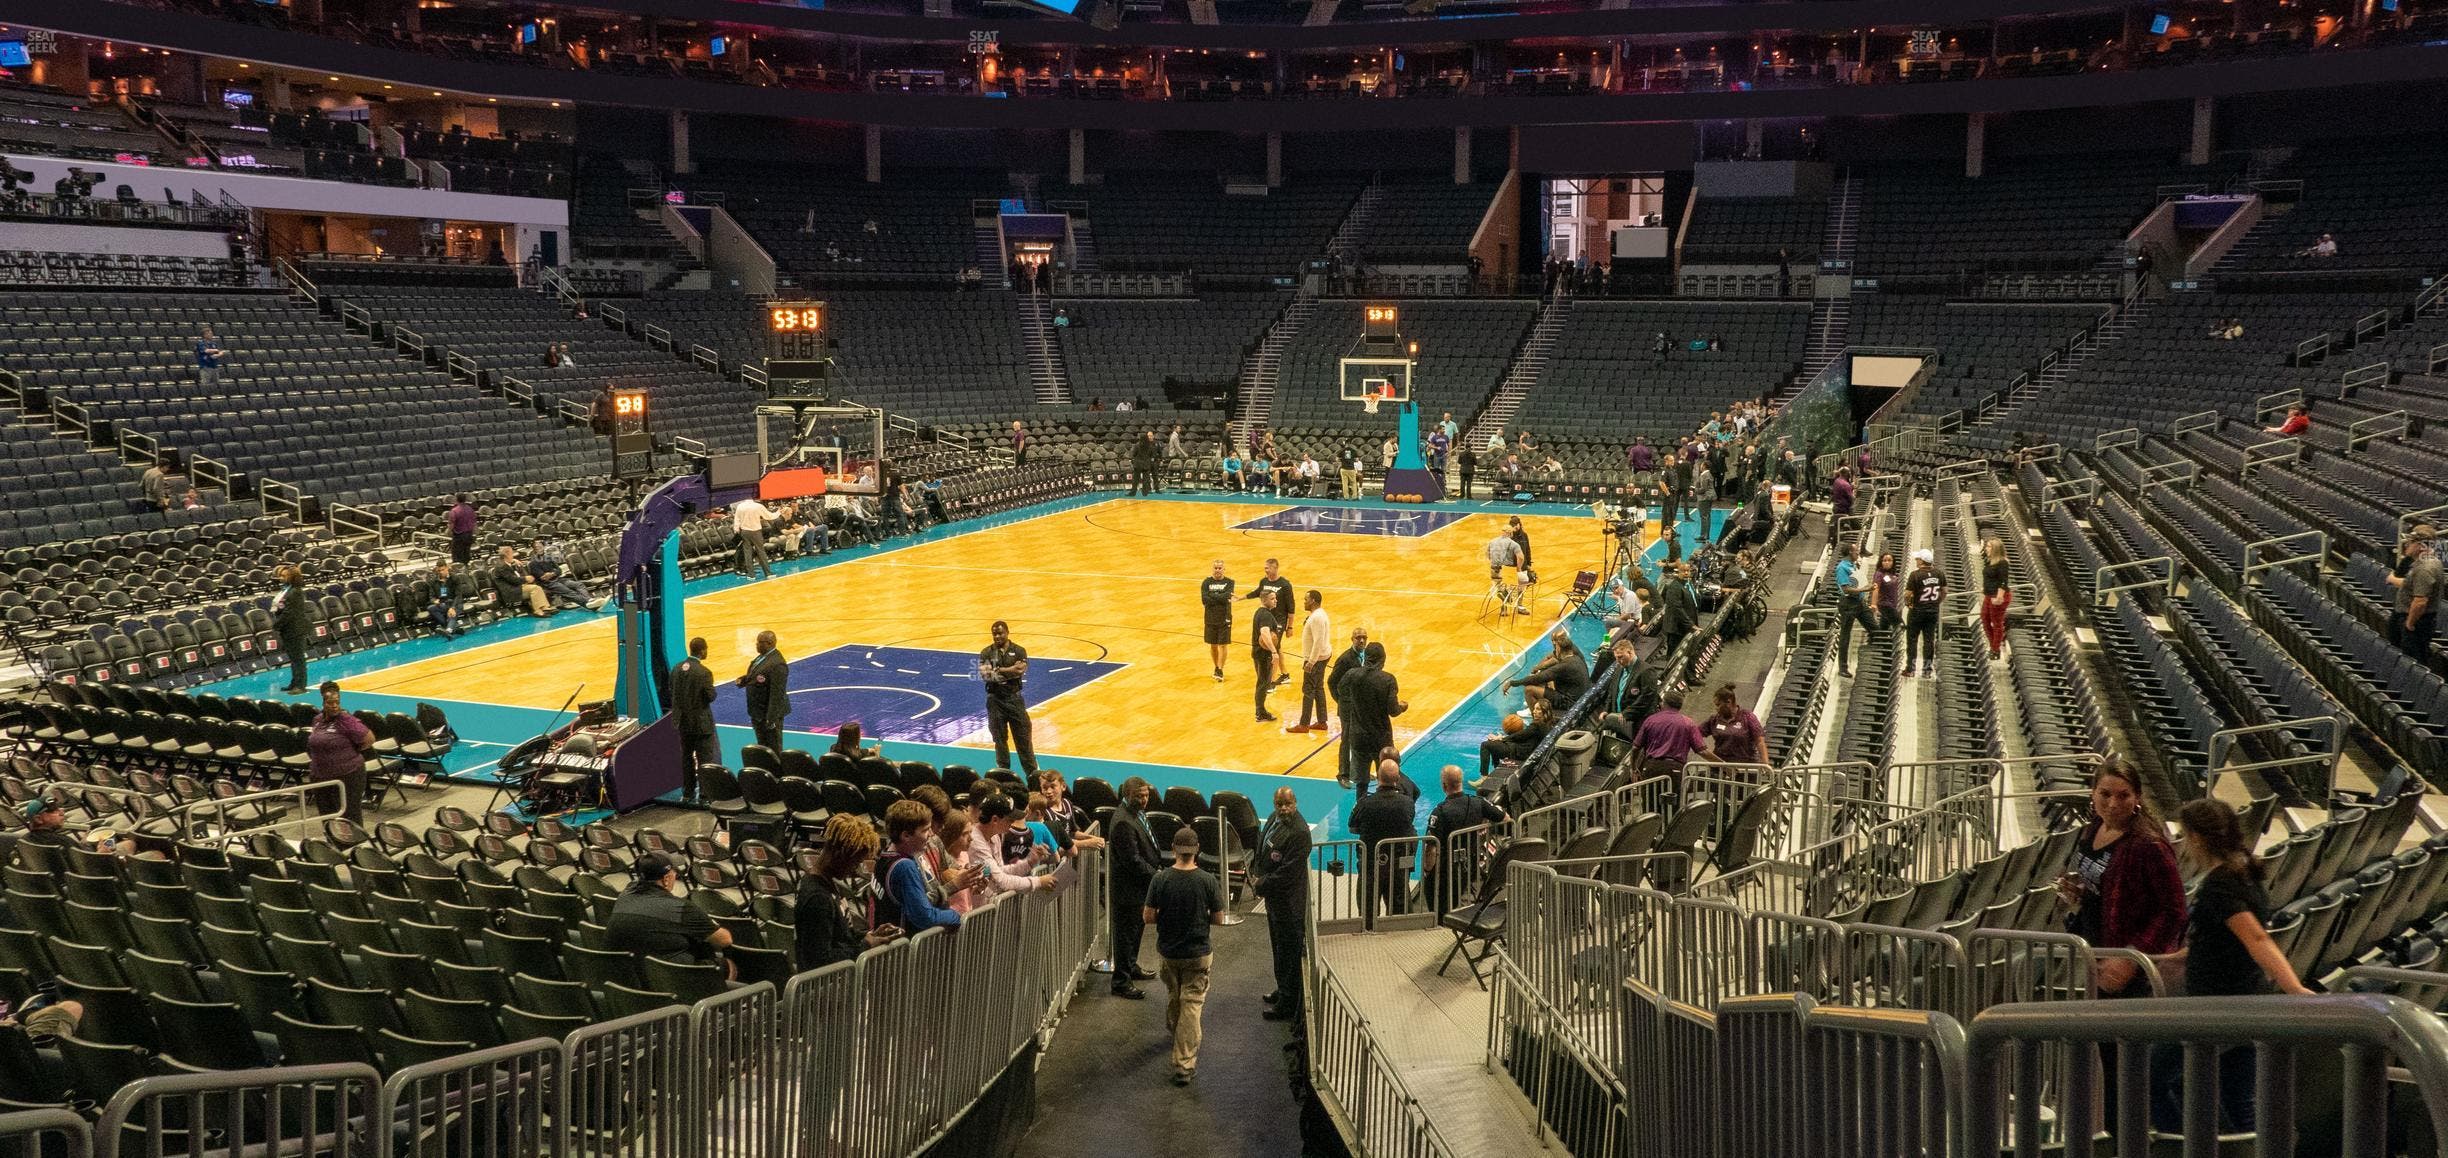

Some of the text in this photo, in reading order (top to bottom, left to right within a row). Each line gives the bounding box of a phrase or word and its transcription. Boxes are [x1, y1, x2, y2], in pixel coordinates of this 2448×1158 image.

[774, 310, 817, 329] 53:13
[1369, 309, 1395, 320] 53:13
[1919, 585, 1941, 601] 25
